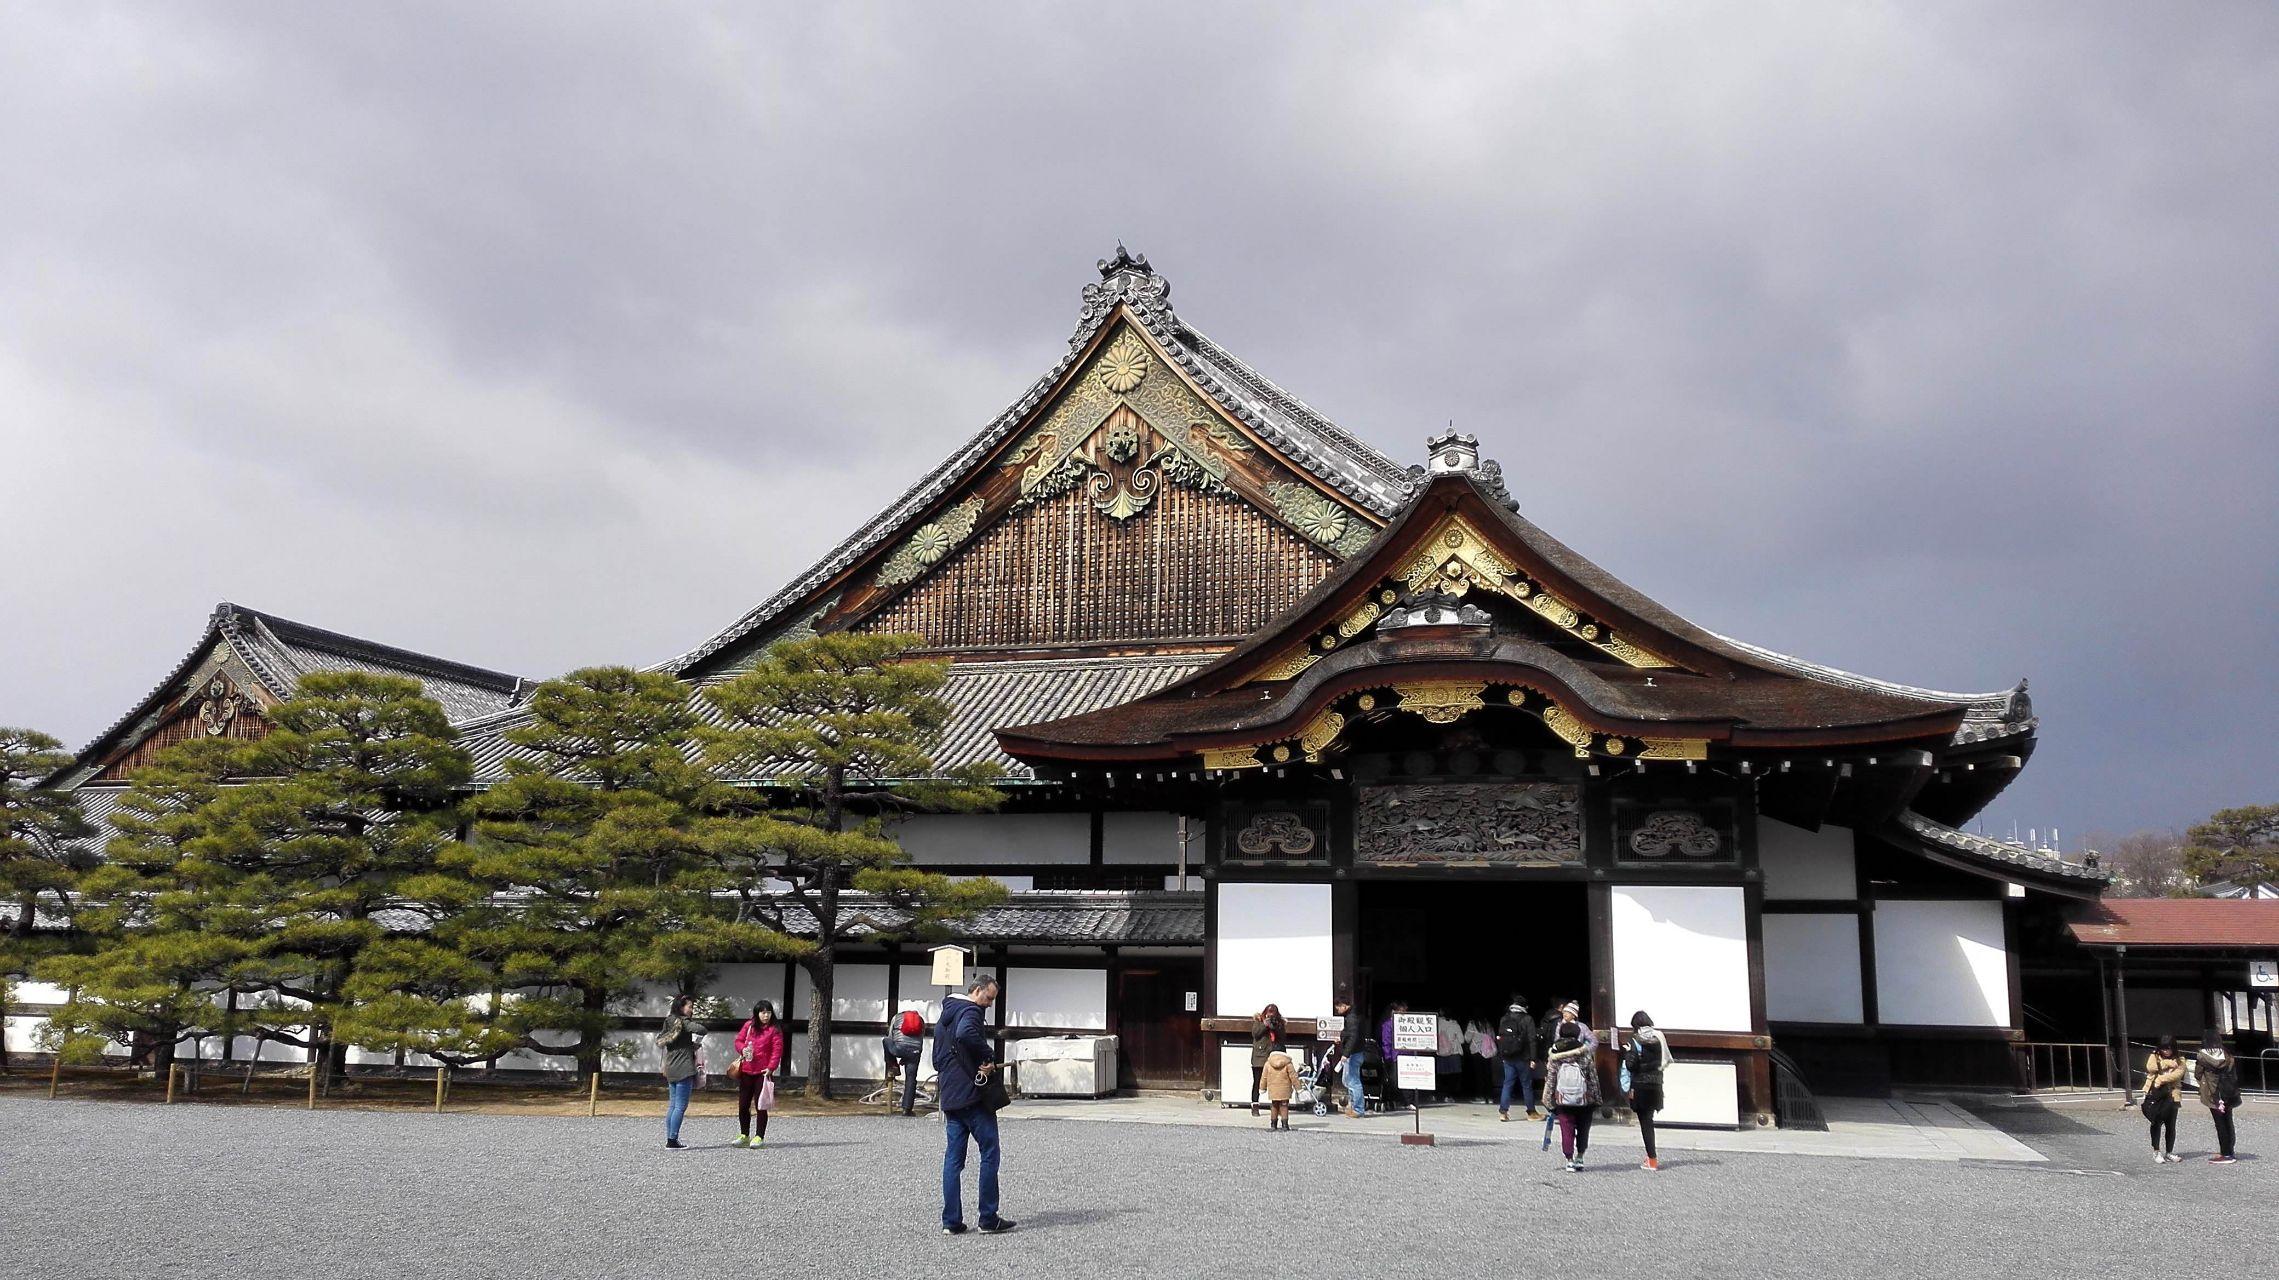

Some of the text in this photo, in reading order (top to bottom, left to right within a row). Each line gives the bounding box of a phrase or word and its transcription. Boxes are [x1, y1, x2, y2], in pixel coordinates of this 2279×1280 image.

[1398, 1016, 1433, 1025] 御殿観覧
[1399, 1025, 1432, 1033] 個人入口
